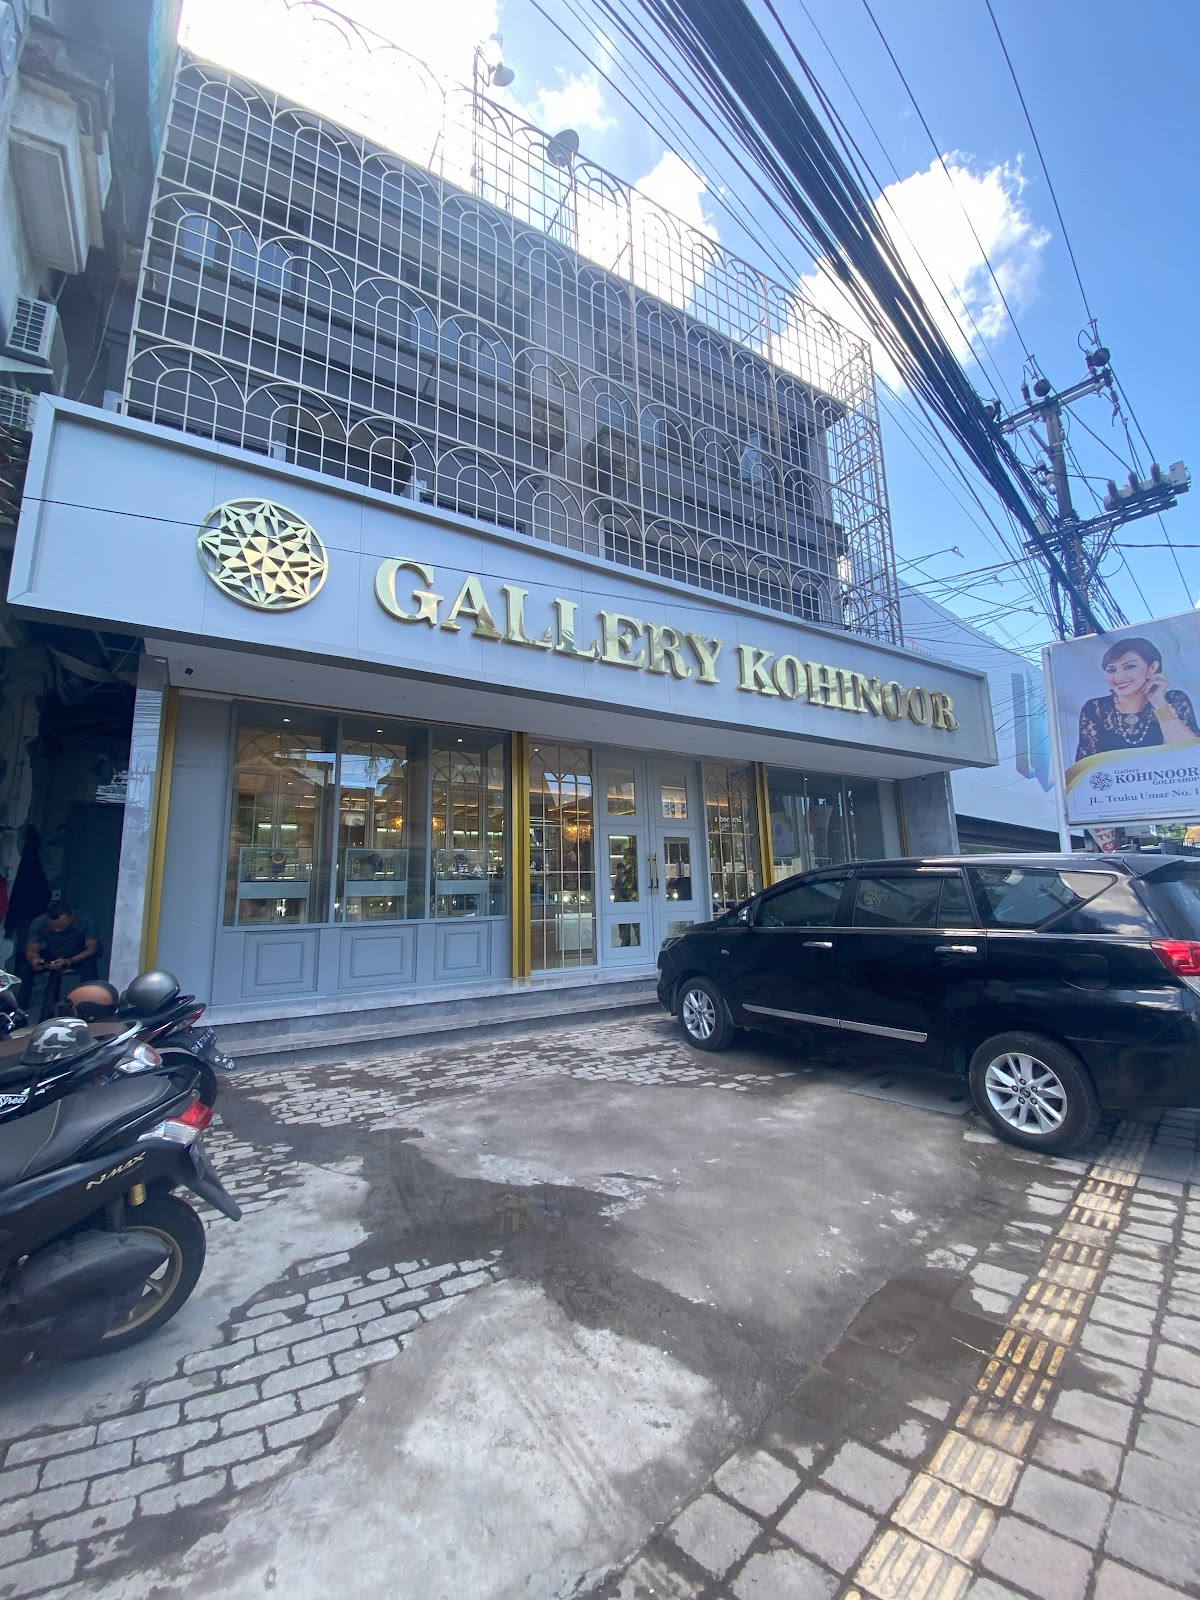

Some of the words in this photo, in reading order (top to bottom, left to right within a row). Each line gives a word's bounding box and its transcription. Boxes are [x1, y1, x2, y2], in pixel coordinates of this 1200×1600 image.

[375, 556, 726, 685] GALLERY
[737, 644, 960, 732] KOHINOOR
[1115, 767, 1200, 784] KOHINOOR
[1176, 776, 1200, 784] SHOP
[1089, 796, 1104, 806] JL.
[1105, 794, 1138, 803] Teuku
[1140, 792, 1169, 800] Umar
[1172, 789, 1192, 797] No.
